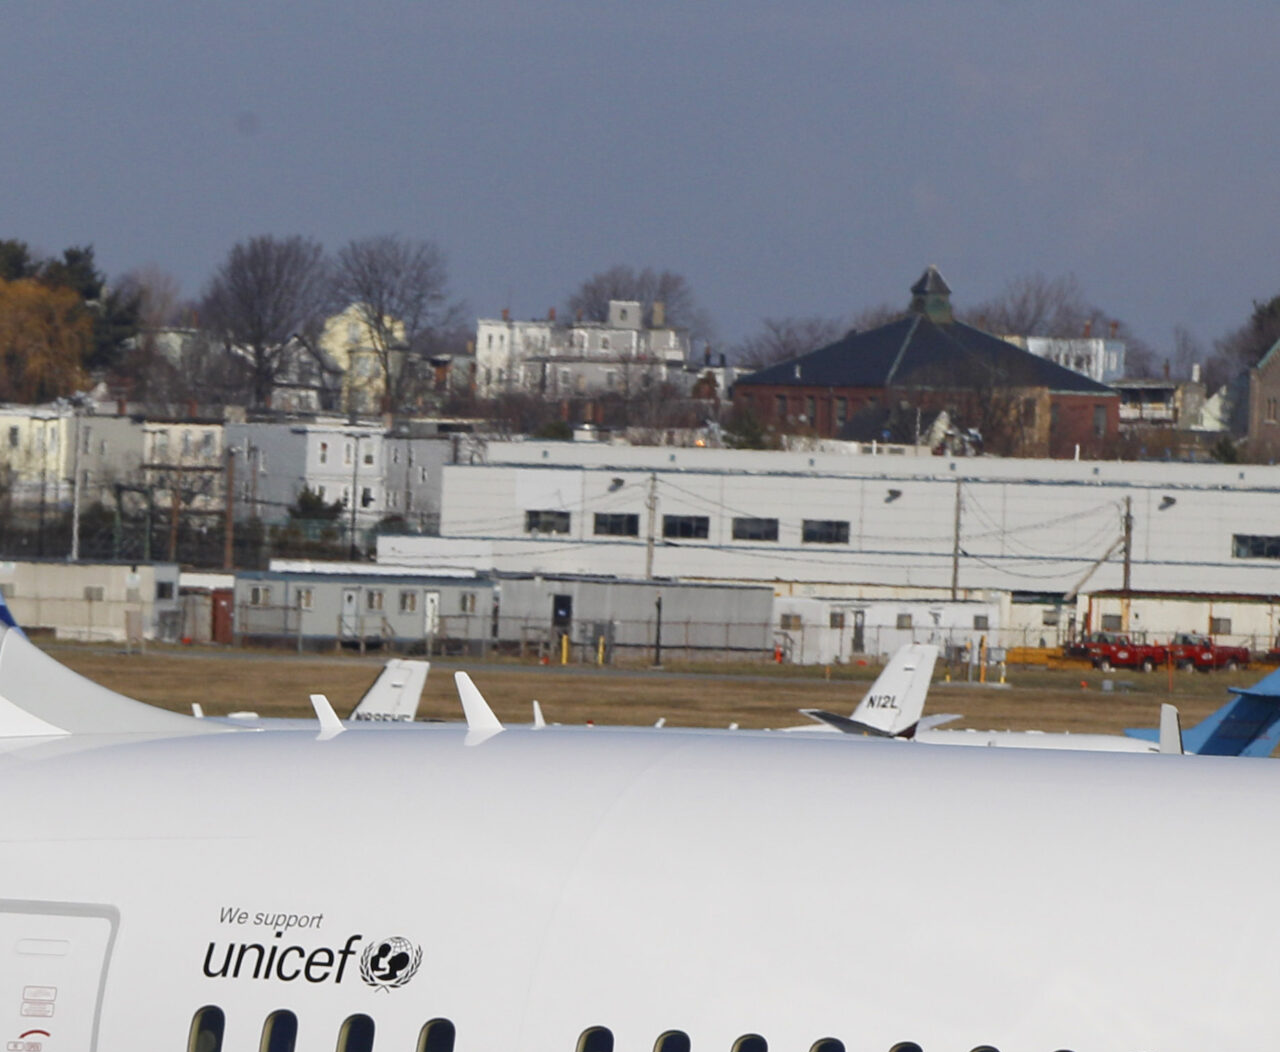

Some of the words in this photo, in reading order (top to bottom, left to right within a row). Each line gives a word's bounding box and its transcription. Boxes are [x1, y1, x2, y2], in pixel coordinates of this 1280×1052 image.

[866, 695, 898, 709] N12L
[219, 907, 249, 925] We
[253, 911, 324, 931] support
[202, 931, 363, 984] unicef
